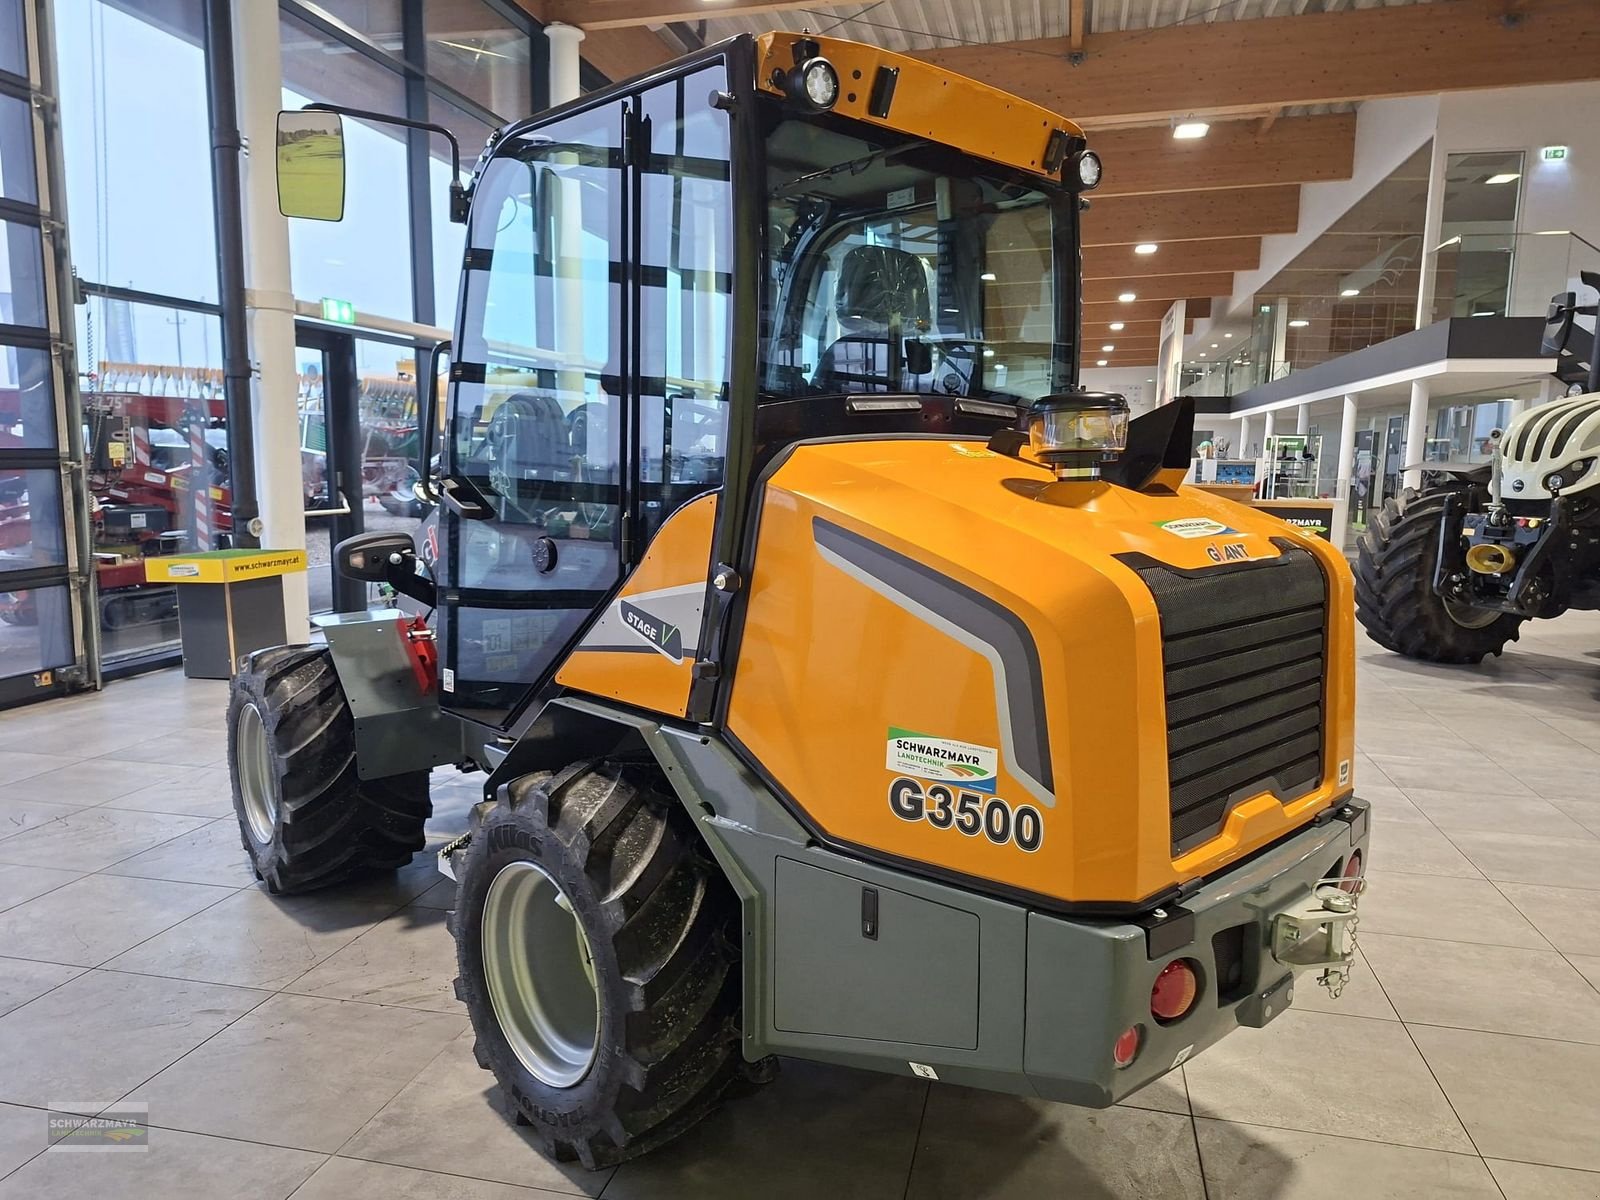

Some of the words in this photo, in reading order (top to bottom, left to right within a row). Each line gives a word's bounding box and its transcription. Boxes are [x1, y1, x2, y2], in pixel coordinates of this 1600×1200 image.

[1282, 518, 1322, 526] RZMAYR
[234, 555, 299, 571] www.schwarzmayr.at
[627, 611, 657, 640] STAGE
[896, 739, 980, 766] SCHWARZMAYR
[897, 751, 945, 768] LANDTECHNIK
[888, 776, 1043, 853] G3500
